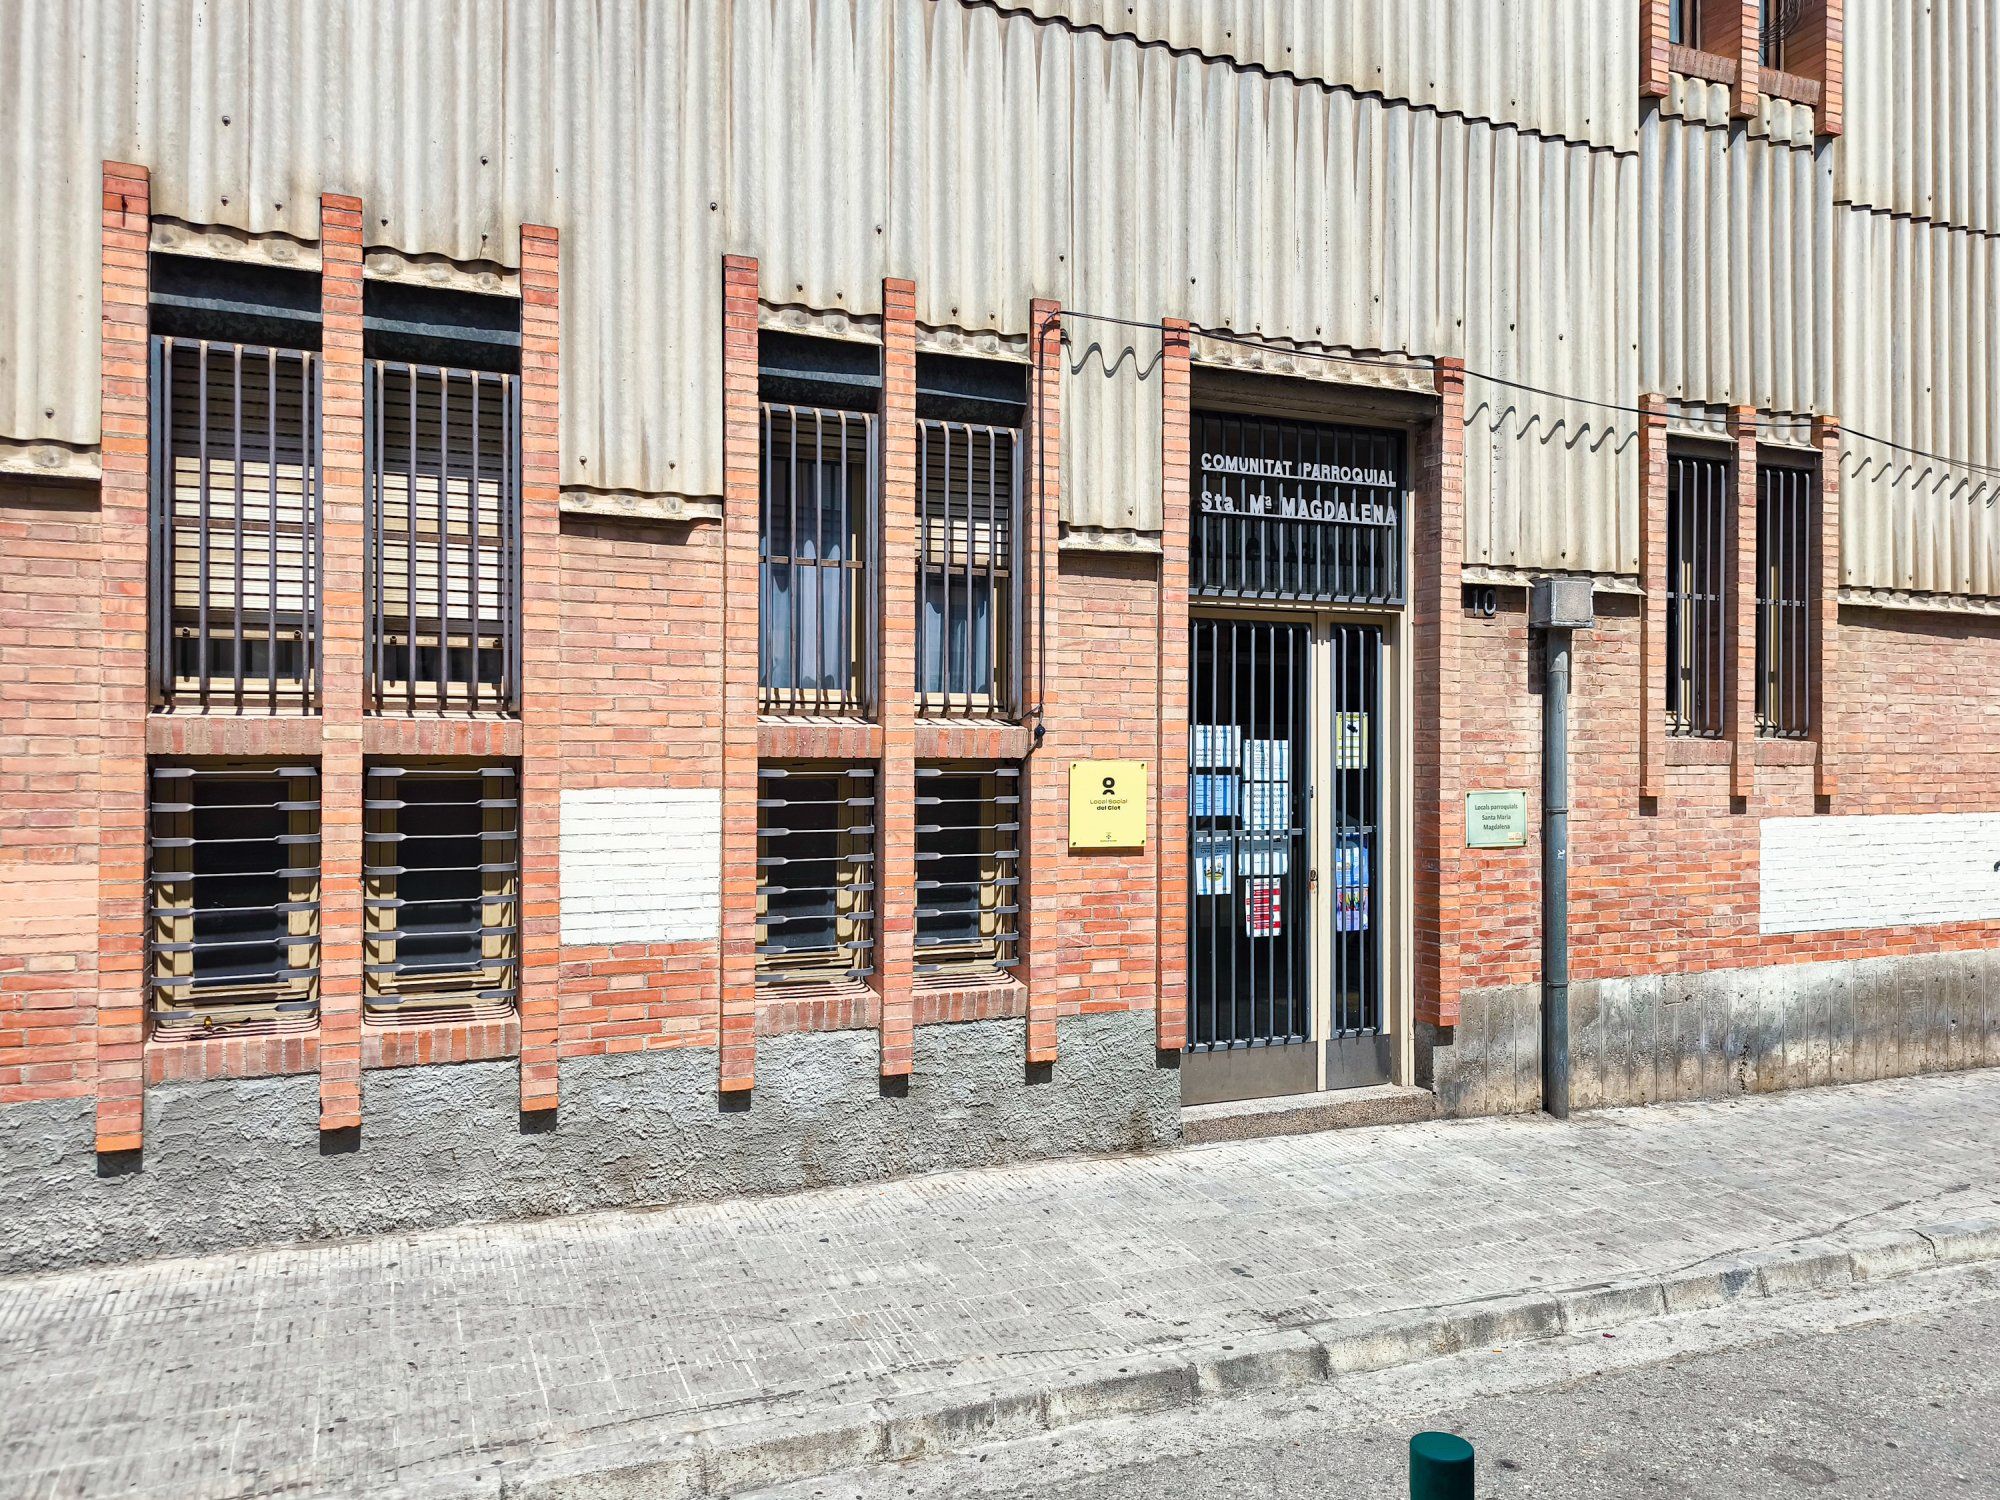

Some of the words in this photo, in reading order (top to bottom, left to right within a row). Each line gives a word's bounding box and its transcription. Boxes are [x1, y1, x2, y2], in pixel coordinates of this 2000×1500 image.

[1201, 453, 1293, 477] COMUNITAT
[1303, 462, 1397, 486] PARROQUIAL
[1201, 490, 1240, 512] Sta.
[1281, 496, 1397, 526] MAGDALENA
